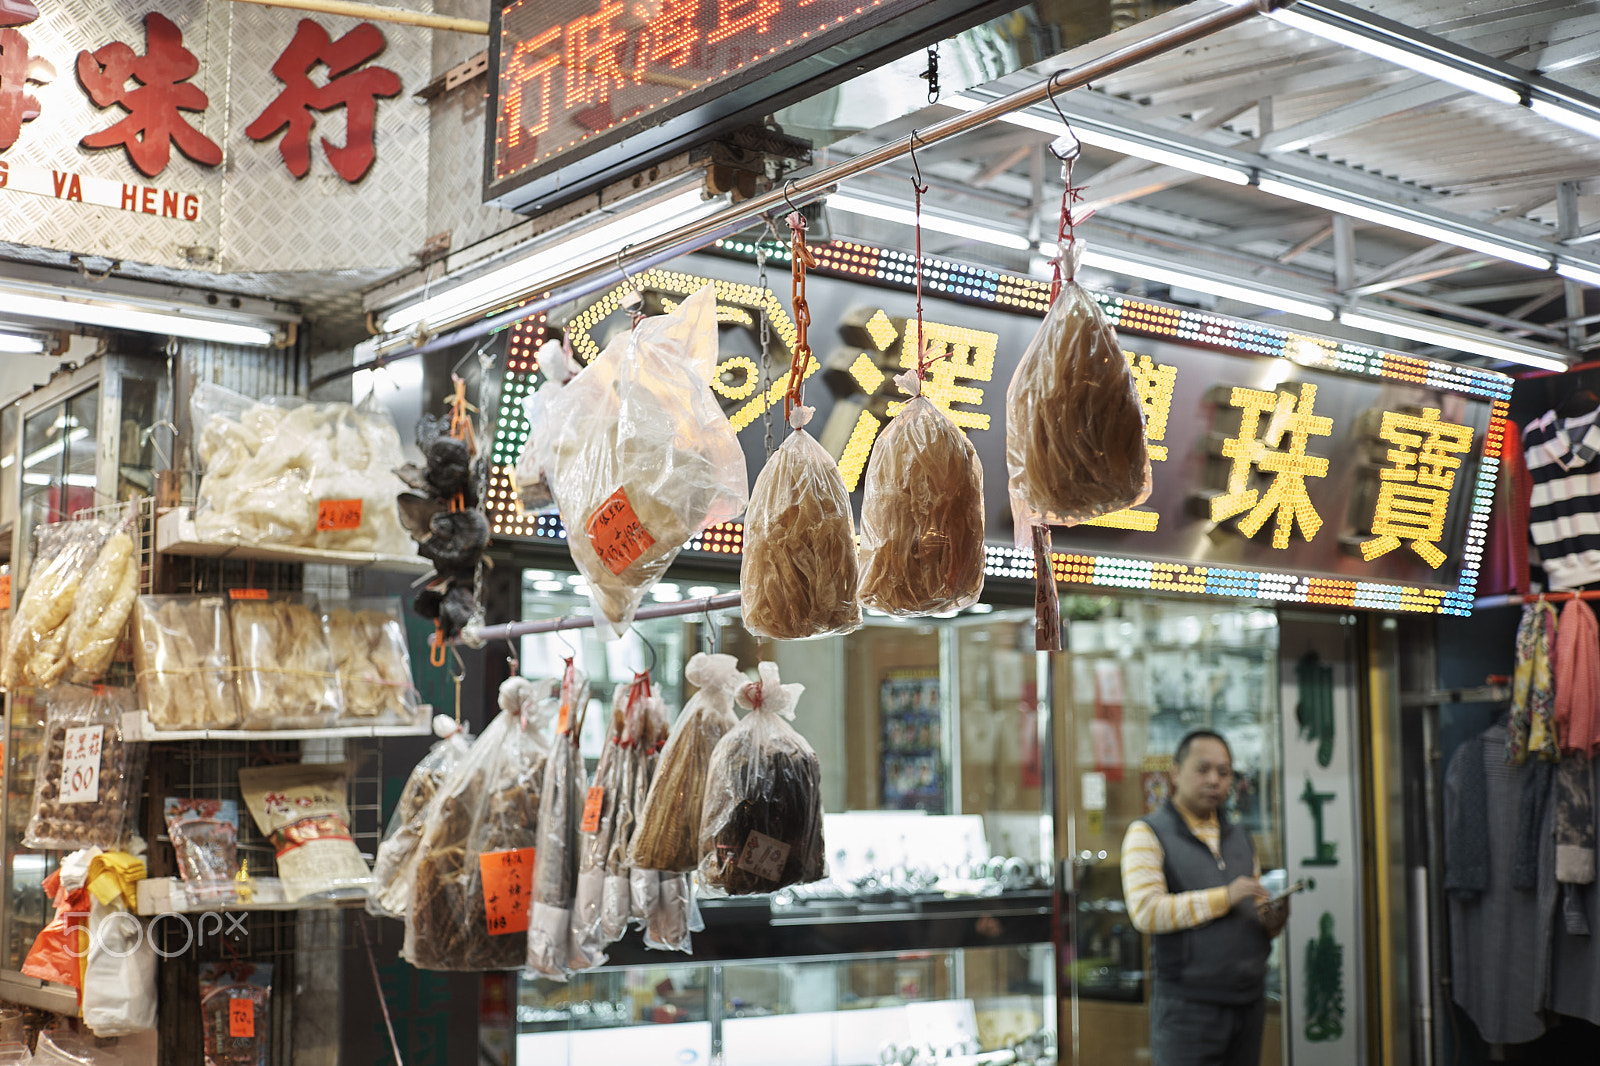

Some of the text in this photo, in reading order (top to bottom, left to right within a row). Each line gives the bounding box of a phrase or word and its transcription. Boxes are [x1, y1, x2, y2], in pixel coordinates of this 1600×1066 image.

[52, 170, 83, 202] VA
[121, 183, 199, 221] HENG
[71, 765, 94, 793] 60
